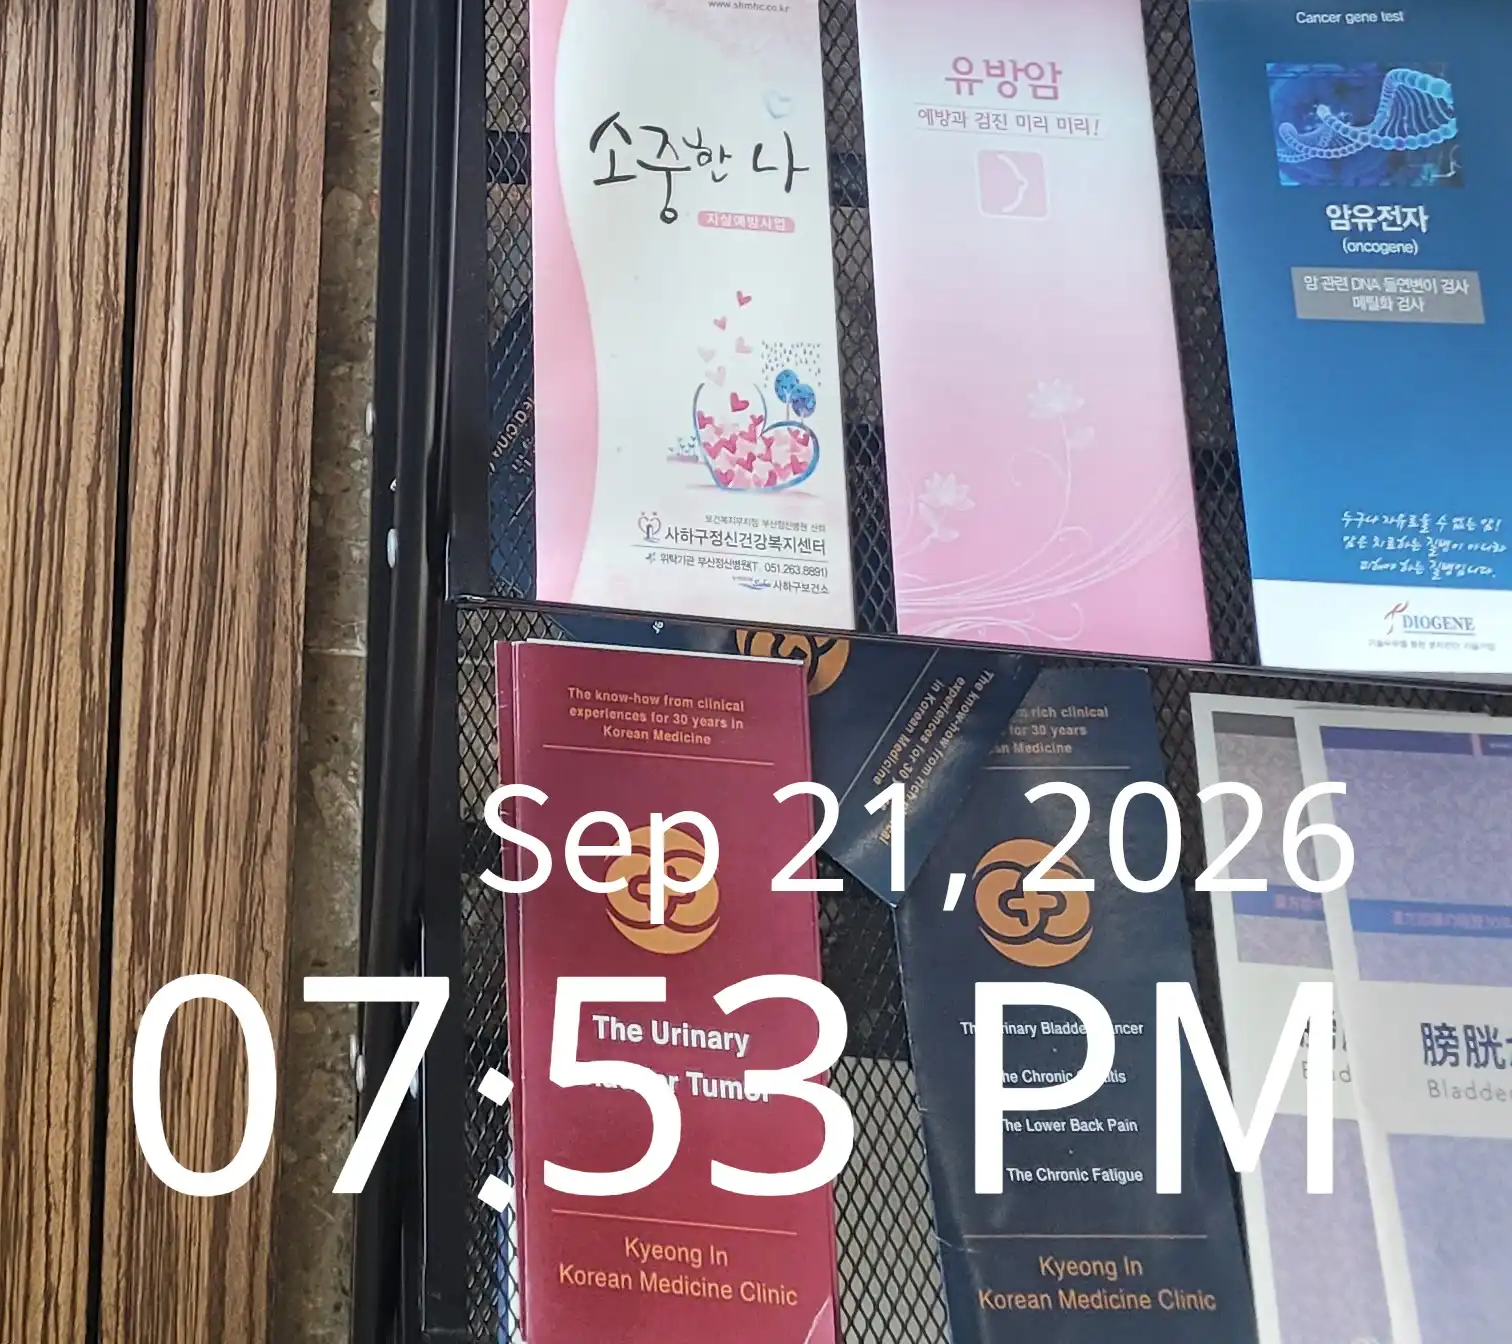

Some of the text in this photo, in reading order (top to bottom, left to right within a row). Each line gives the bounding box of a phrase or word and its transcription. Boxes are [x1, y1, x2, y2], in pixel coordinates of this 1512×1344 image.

[1295, 10, 1404, 25] Cancer gene test
[945, 56, 1063, 101] 유방암
[975, 111, 1009, 131] 검진
[1016, 114, 1049, 134] 미리
[1057, 116, 1100, 137] 미리!
[589, 111, 810, 224] 소중한 나
[1325, 203, 1430, 234] 암유전자
[1342, 237, 1419, 255] (oncogene)
[1351, 277, 1379, 291] DNA
[1441, 278, 1469, 296] 검사
[664, 525, 827, 556] 사하구정신건강복지센터
[773, 580, 829, 595] 사하구보건소
[1401, 614, 1476, 631] DIOGENE
[974, 669, 995, 692] The
[568, 687, 745, 712] The know-how from clinical
[920, 676, 966, 744] experiences
[569, 706, 744, 730] experiences for 30 years in
[907, 693, 936, 734] Korean
[939, 690, 981, 750] know-how
[1031, 706, 1057, 718] rich
[1061, 706, 1109, 718] clinical
[603, 725, 711, 745] Korean Medicine
[1031, 725, 1046, 736] 30
[1051, 725, 1087, 738] years
[872, 734, 911, 786] Medicine
[1013, 742, 1072, 754] Medicine
[899, 763, 913, 779] 30
[922, 748, 944, 777] from
[592, 1014, 750, 1058] The Urinary
[1041, 1021, 1088, 1035] Bladde
[1420, 1021, 1512, 1071] 膀胱
[1022, 1069, 1073, 1083] Chronic
[1026, 1118, 1066, 1132] Lower
[1070, 1118, 1104, 1132] Back
[1107, 1118, 1138, 1132] Pain
[1006, 1167, 1143, 1185] The Chronic Fatigue
[625, 1236, 728, 1268] Kyeong In
[1039, 1255, 1143, 1281] Kyeong In
[559, 1263, 798, 1306] Korean Medicine Clinic
[978, 1287, 1217, 1311] Korean Medicine Clinic
